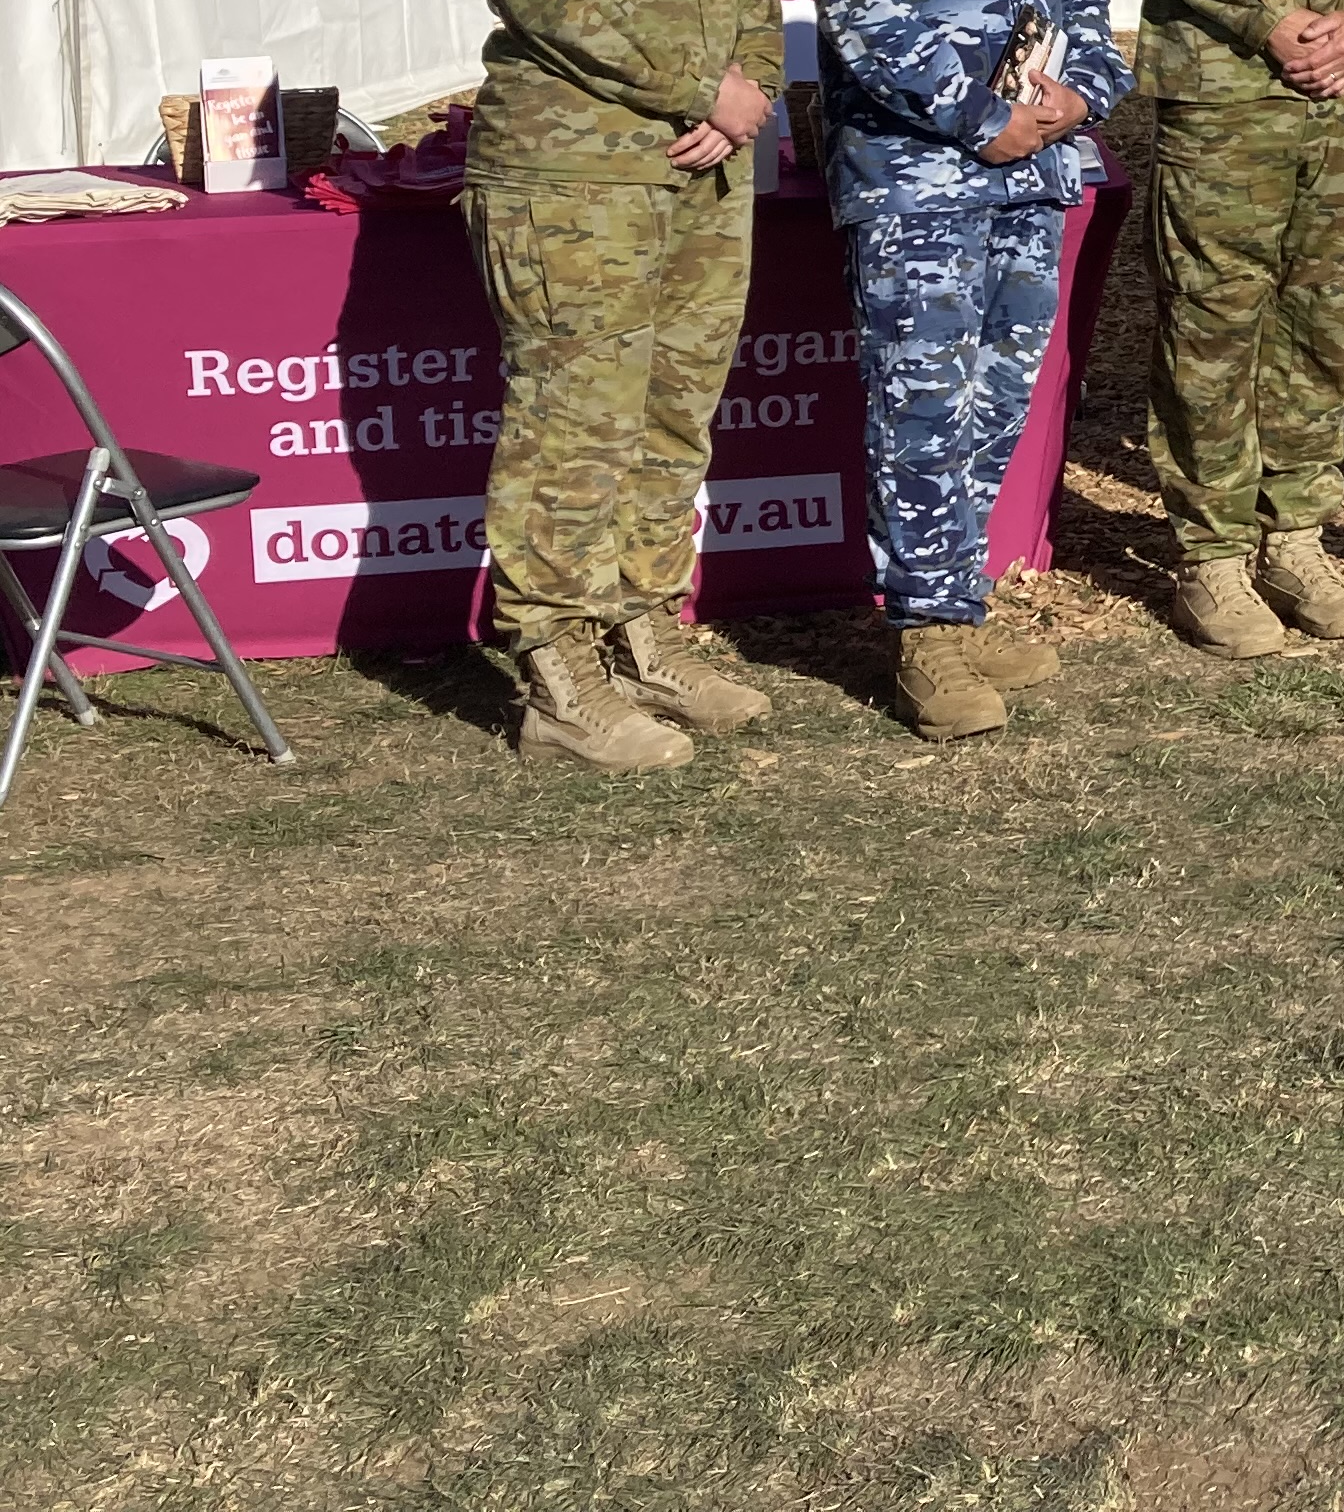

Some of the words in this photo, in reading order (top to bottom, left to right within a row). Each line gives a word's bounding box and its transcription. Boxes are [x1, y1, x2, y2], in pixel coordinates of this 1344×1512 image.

[184, 343, 478, 402] Register
[730, 326, 861, 376] rgan
[268, 405, 399, 456] and
[717, 388, 820, 430] nor
